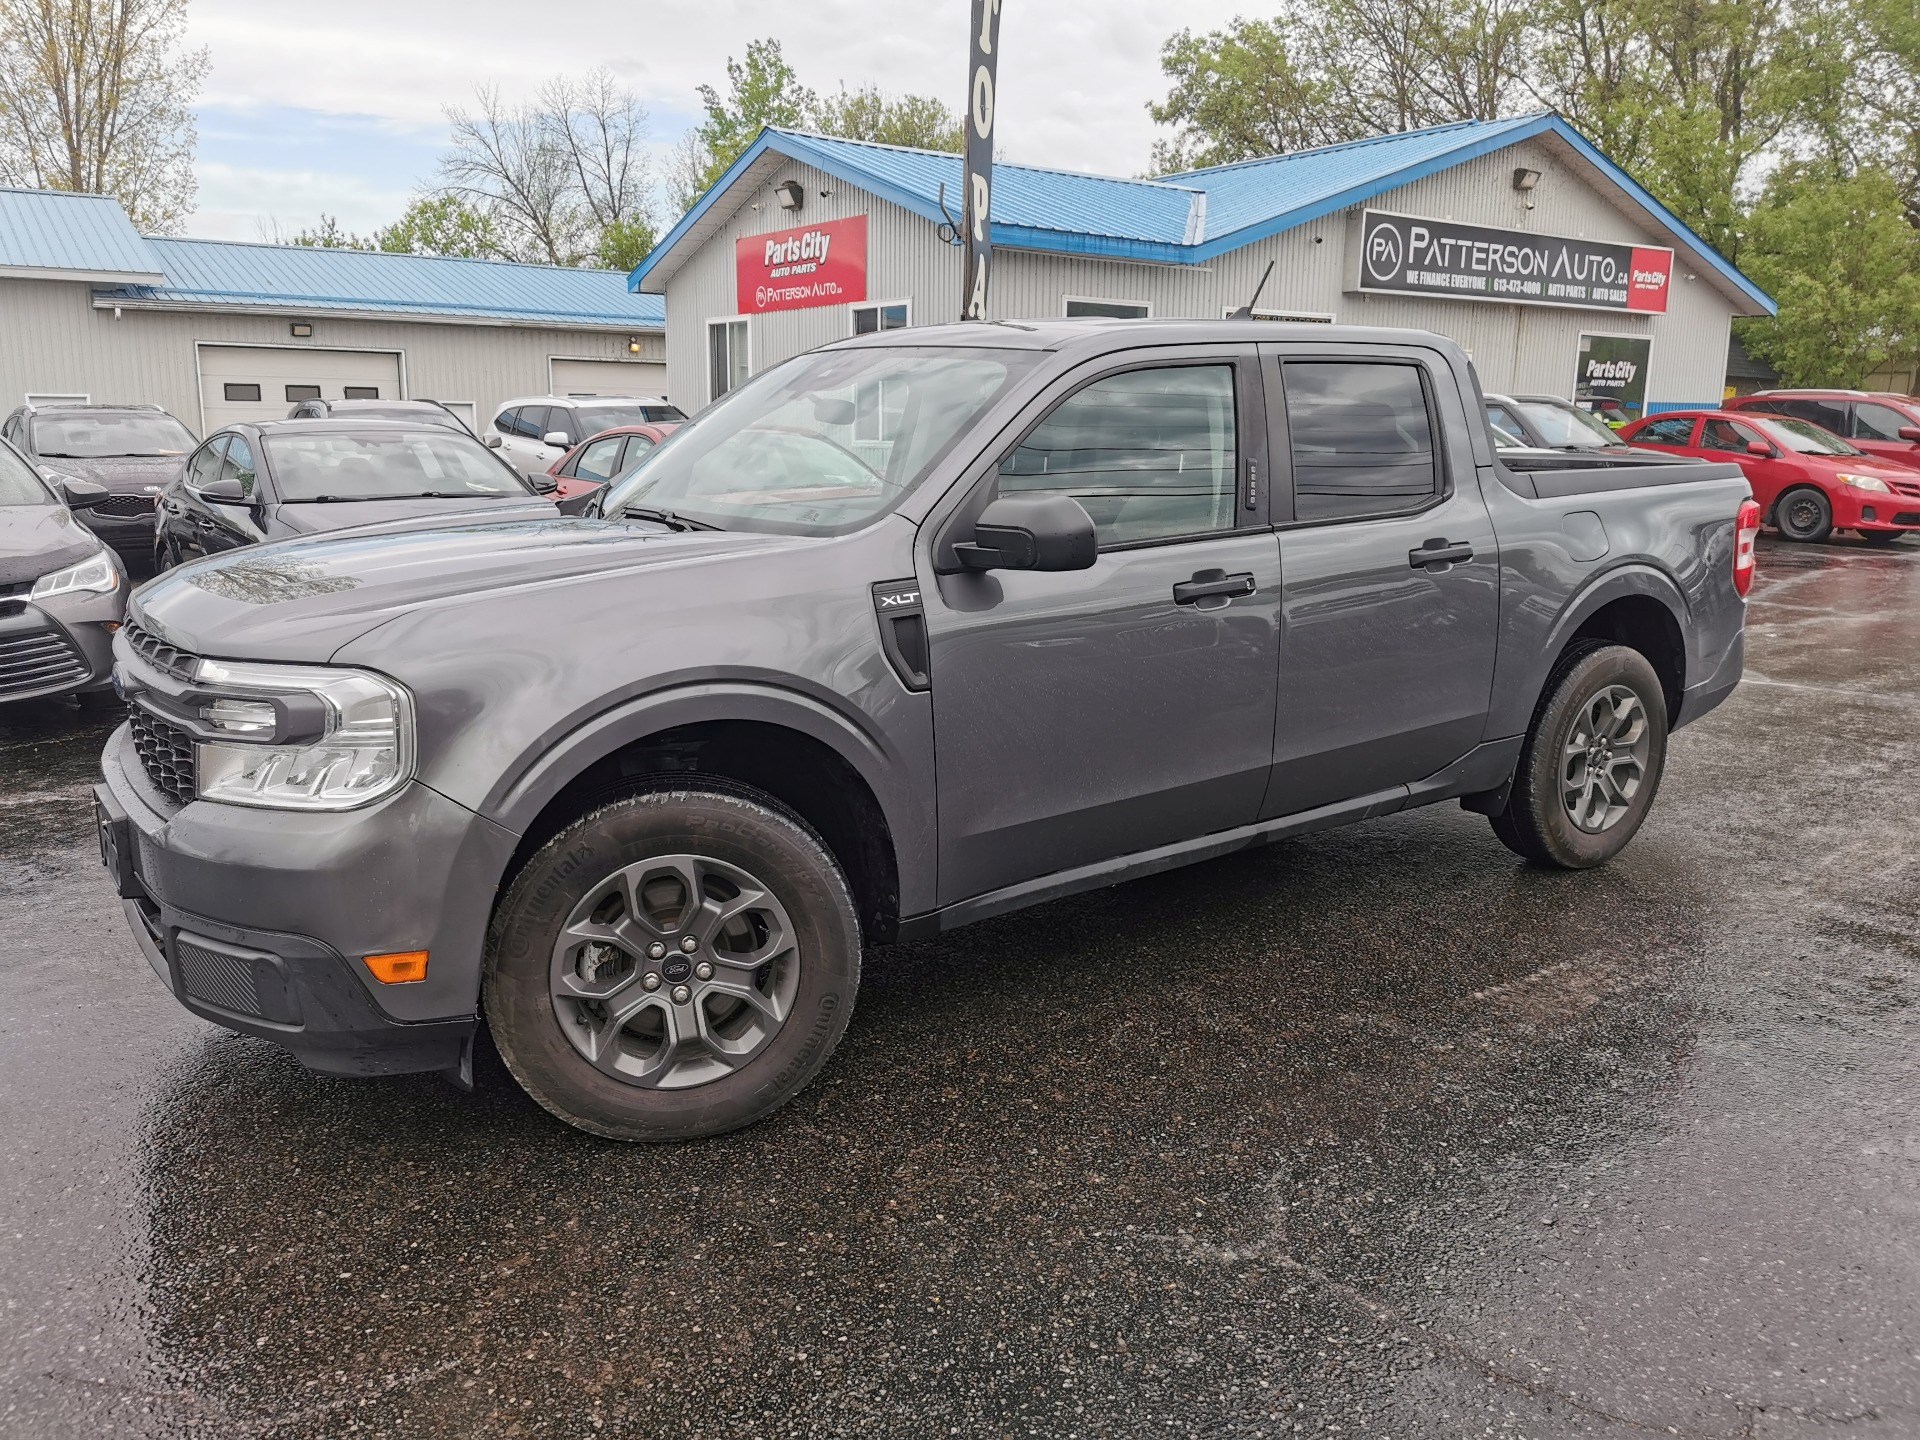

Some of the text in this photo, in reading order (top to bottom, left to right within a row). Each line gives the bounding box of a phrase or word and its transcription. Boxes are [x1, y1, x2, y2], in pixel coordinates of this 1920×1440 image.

[764, 230, 831, 267] PartsCity
[1408, 226, 1549, 276] PATTERSON
[770, 262, 817, 278] AUTO PARTS
[767, 285, 811, 303] PATTERSON
[1406, 270, 1628, 303] WE FINANCE EVERYONE 613-473-4000 AUTO PARTS AUTO SALES
[1590, 379, 1607, 387] AUTO
[1606, 380, 1626, 388] PARTS
[881, 592, 920, 607] XLT
